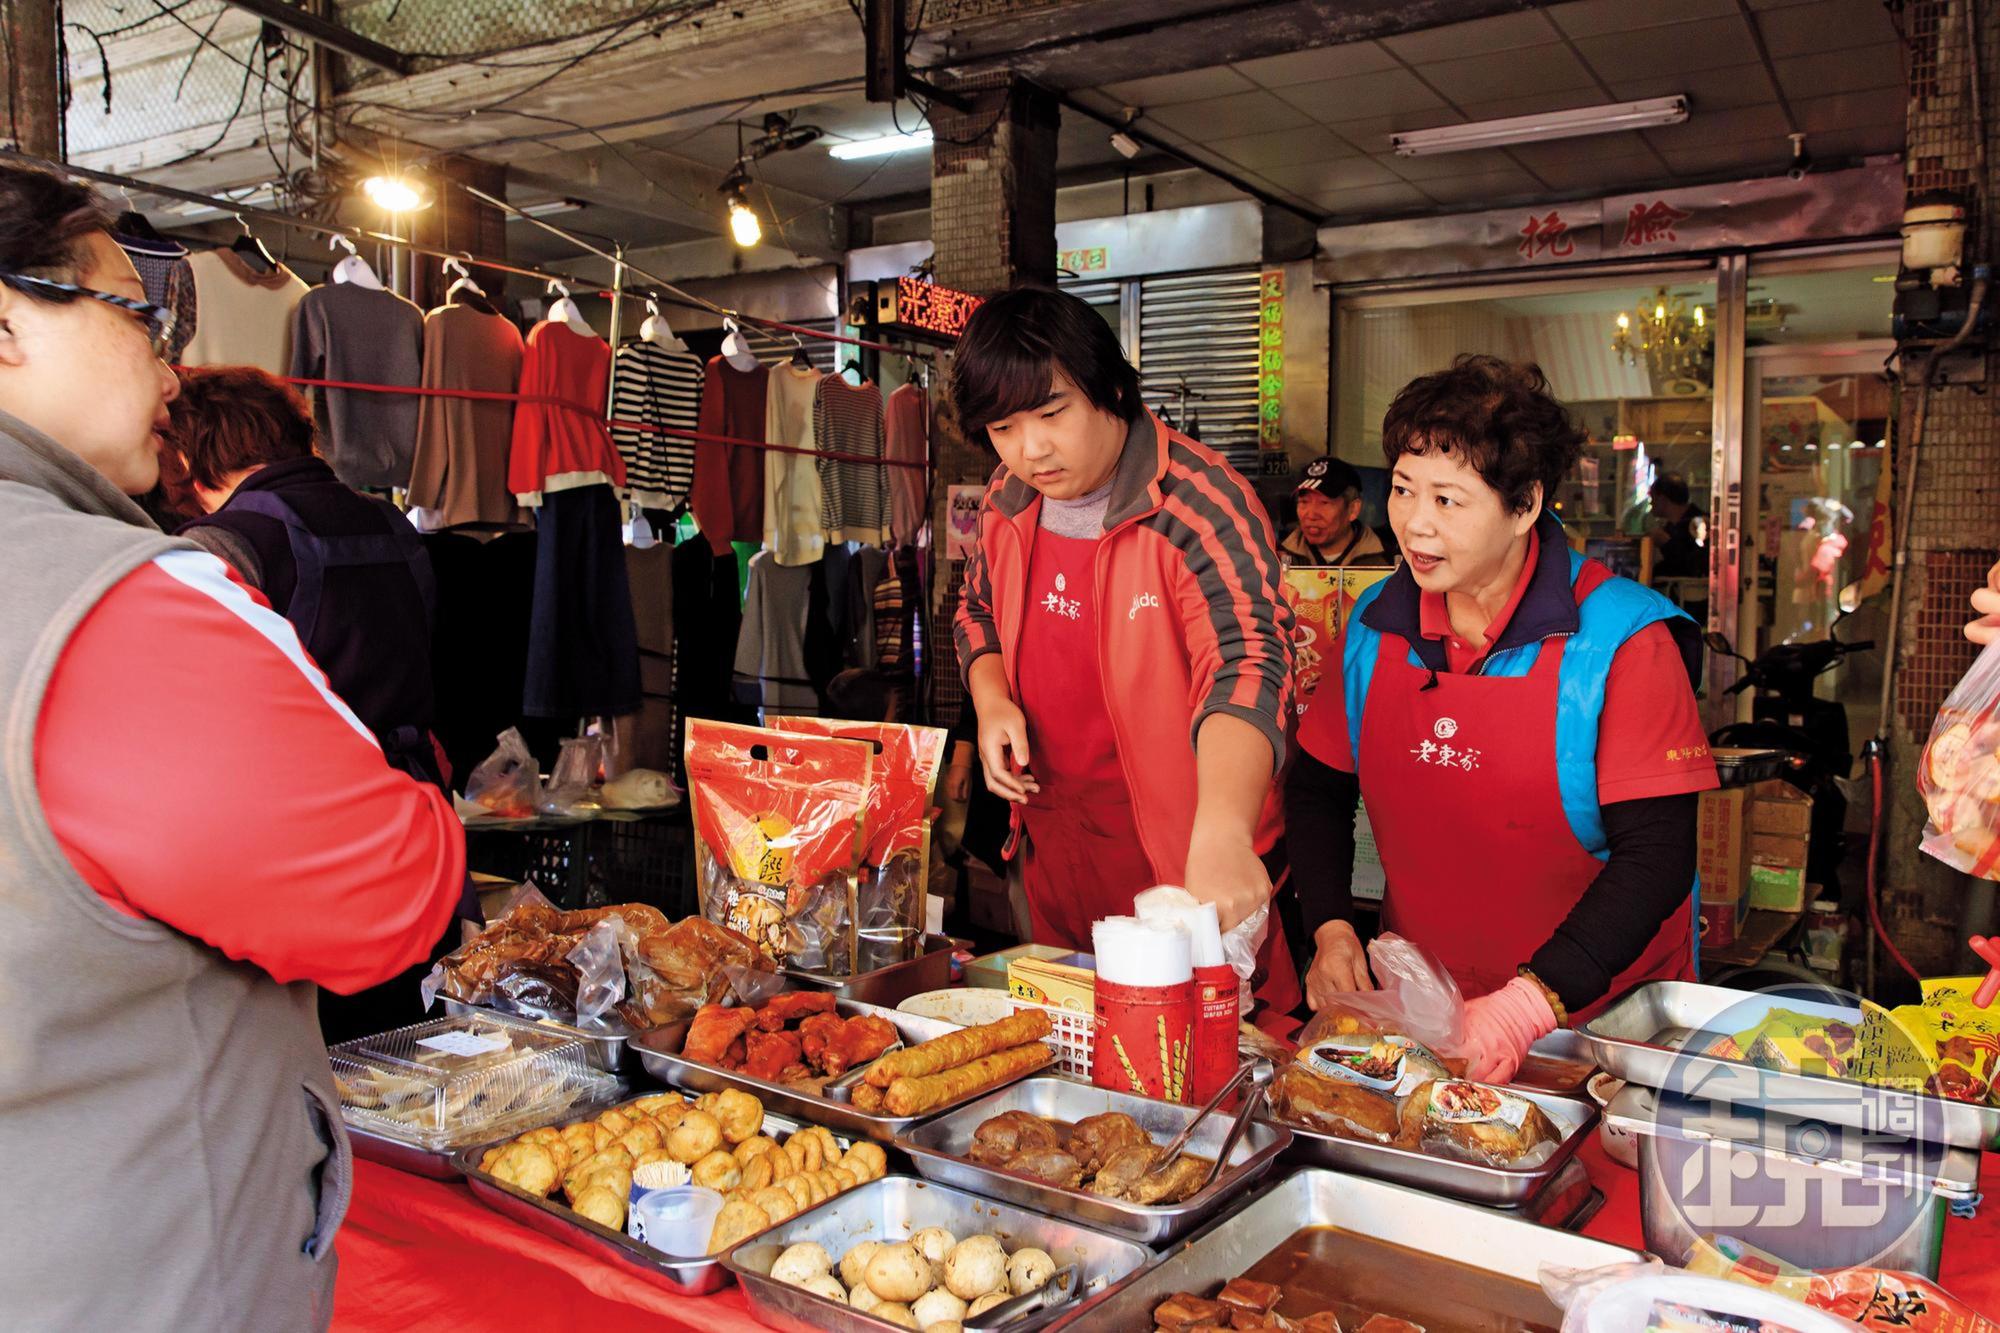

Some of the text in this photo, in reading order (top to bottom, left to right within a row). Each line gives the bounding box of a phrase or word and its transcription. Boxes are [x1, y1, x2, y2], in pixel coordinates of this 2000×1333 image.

[1041, 592, 1081, 620] 老東家
[1410, 739, 1481, 772] 老東家
